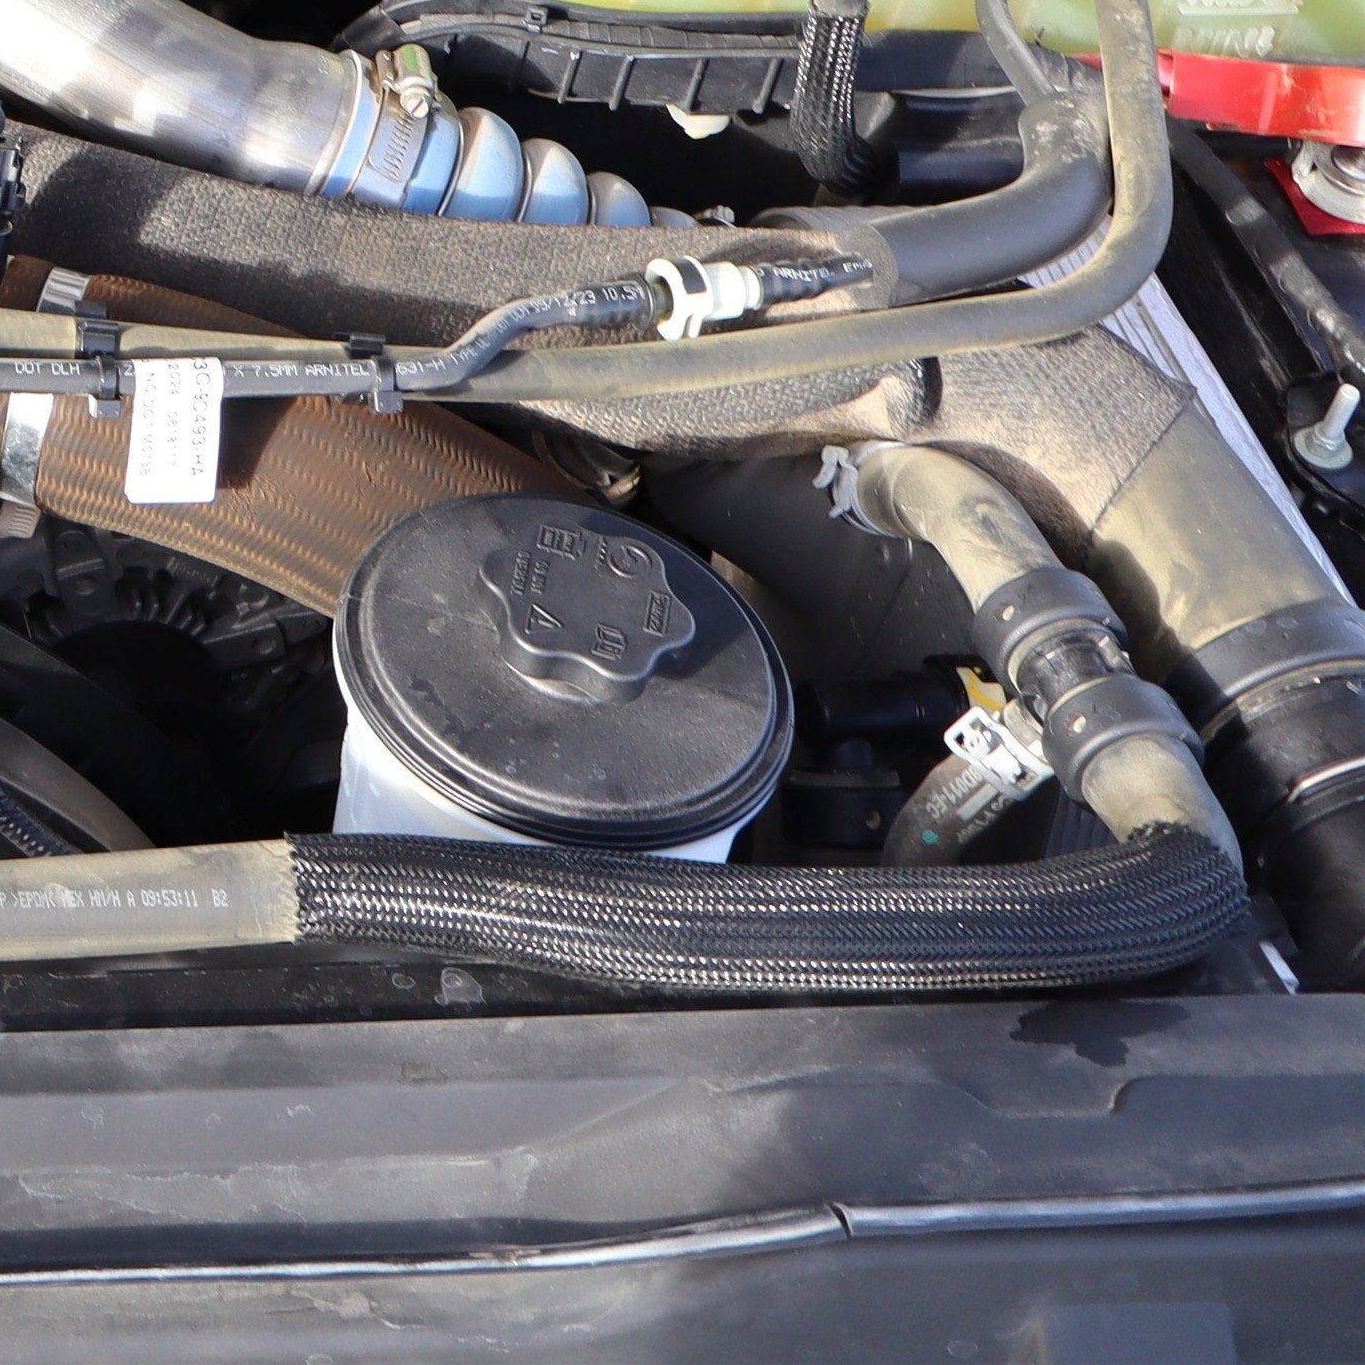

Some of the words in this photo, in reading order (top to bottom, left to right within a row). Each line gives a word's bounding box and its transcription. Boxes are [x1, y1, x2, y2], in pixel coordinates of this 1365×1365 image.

[232, 365, 244, 377] X
[254, 364, 299, 378] 7.5MM
[305, 363, 370, 376] ARNITEL
[395, 360, 446, 376] 631-H
[126, 889, 137, 908] A
[141, 888, 199, 908] 09:53:11
[212, 888, 230, 908] B2
